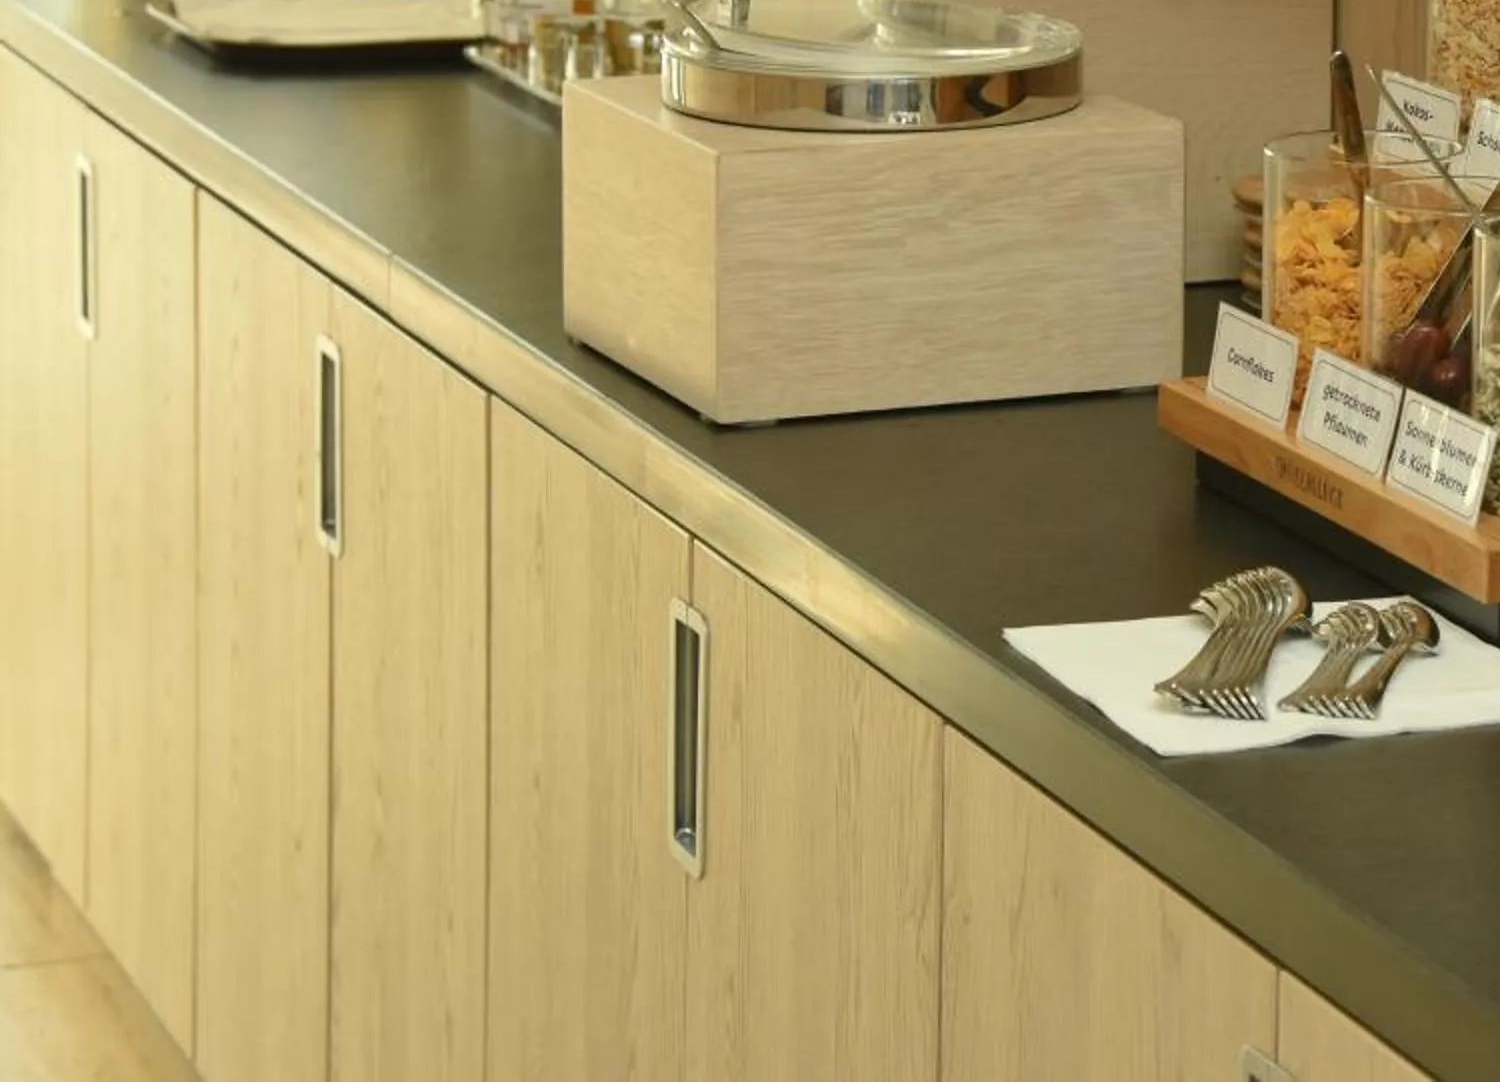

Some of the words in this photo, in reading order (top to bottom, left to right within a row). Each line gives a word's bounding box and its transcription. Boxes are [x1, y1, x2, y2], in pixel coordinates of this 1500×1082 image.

[1227, 347, 1275, 383] Cornflakes
[1322, 384, 1381, 423] getrocknete
[1323, 411, 1369, 447] Pflaumen
[1410, 454, 1468, 497] Kürbskerne
